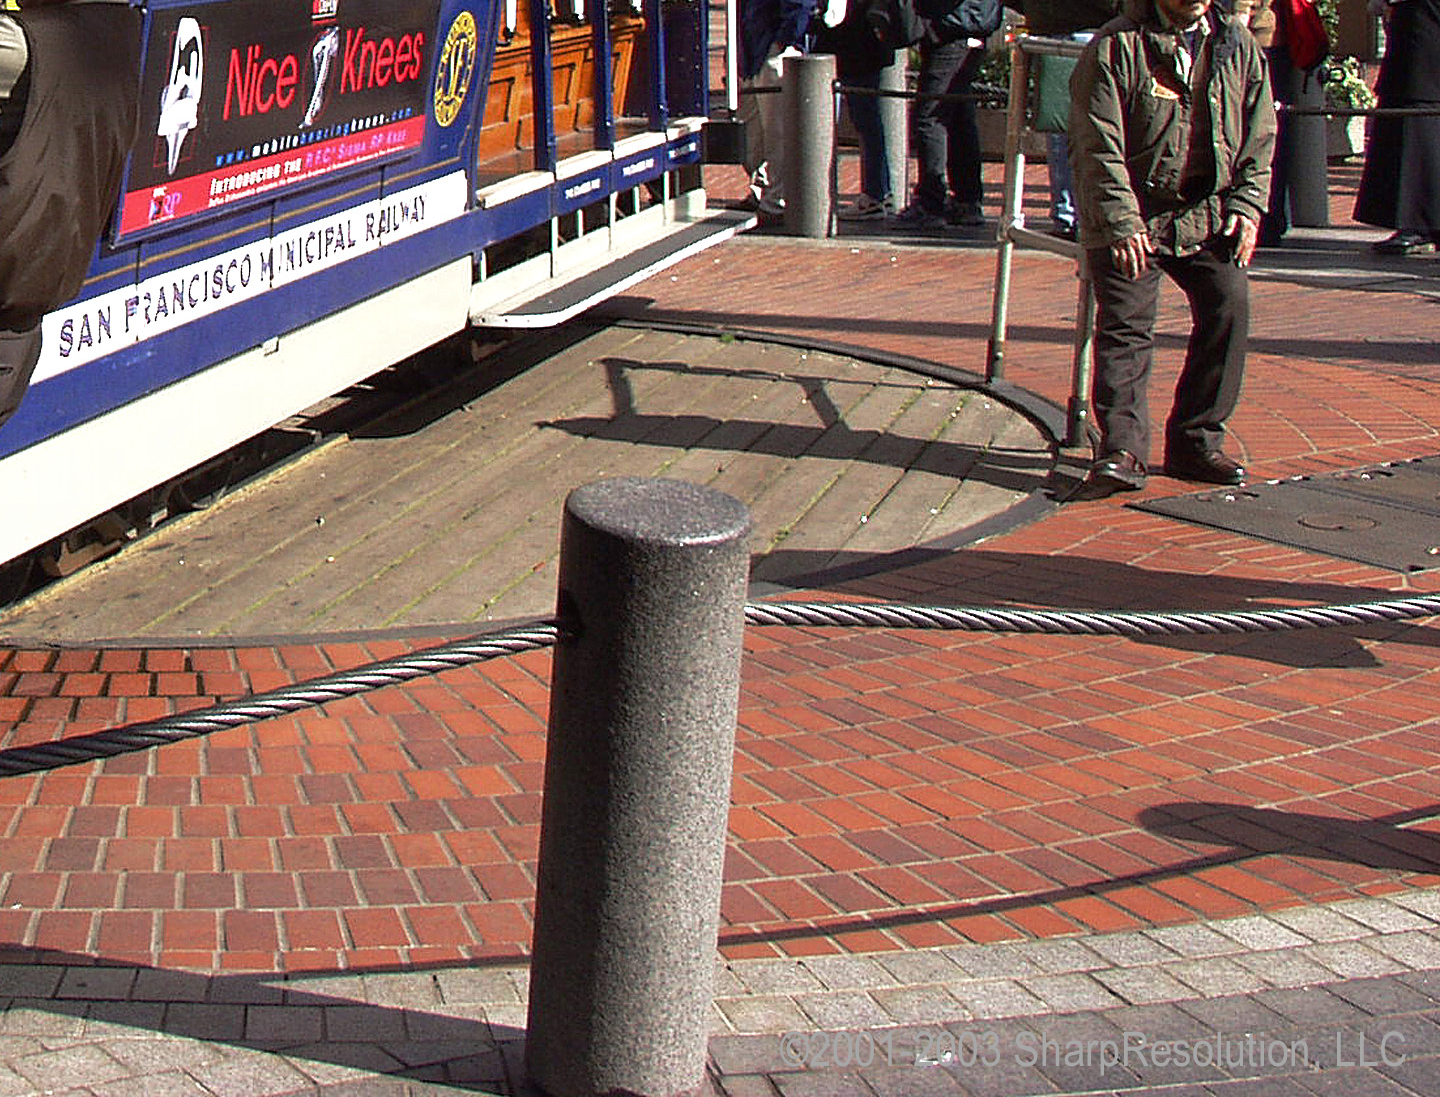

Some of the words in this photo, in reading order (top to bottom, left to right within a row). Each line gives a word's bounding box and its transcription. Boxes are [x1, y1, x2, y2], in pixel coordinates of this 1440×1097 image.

[222, 44, 299, 121] Nice
[340, 26, 425, 94] Knees
[210, 163, 281, 196] INTRODUCING
[59, 305, 112, 358] SAN
[124, 253, 252, 333] FRANCISCO
[259, 219, 357, 282] MUNICIPAL
[365, 194, 428, 243] RAILWAY
